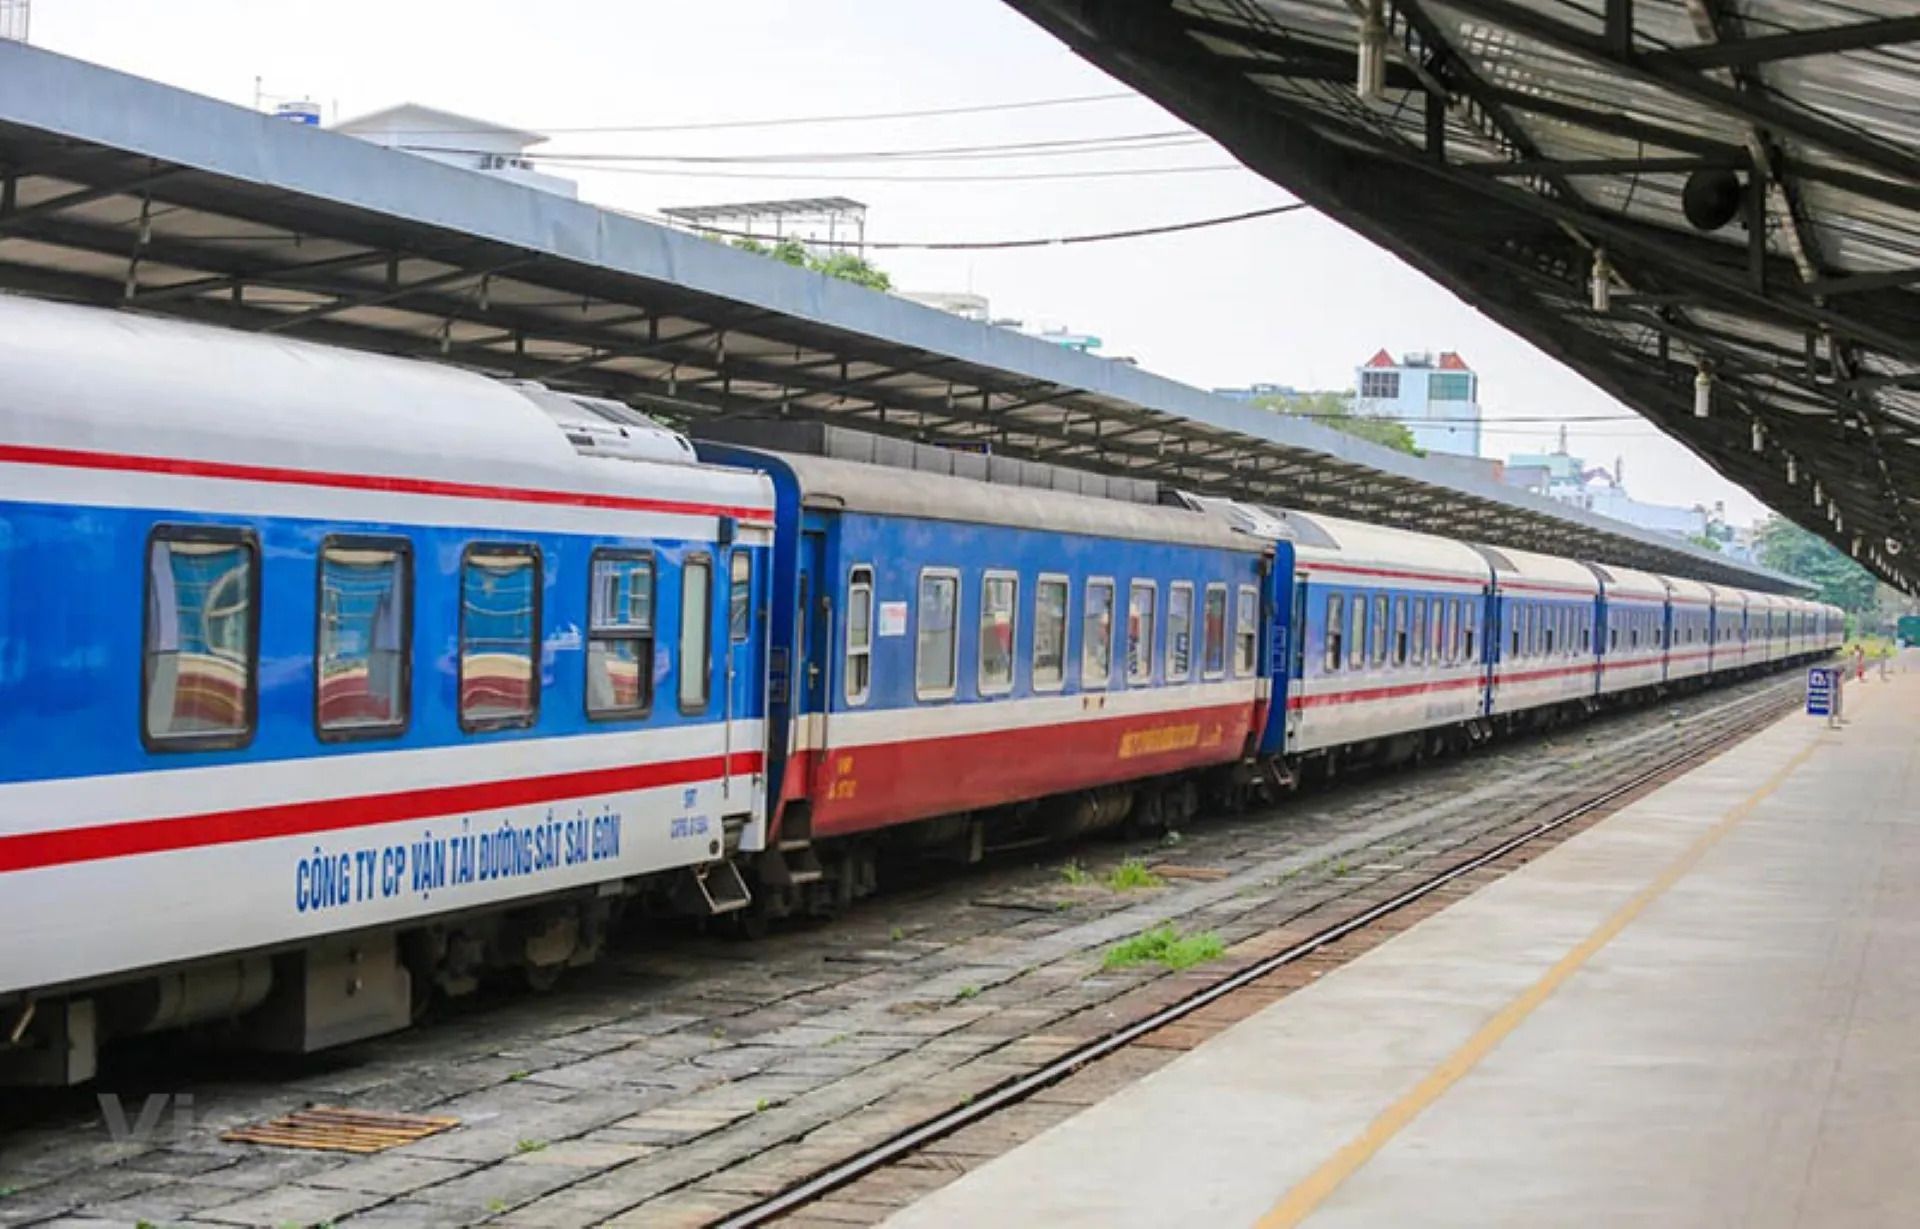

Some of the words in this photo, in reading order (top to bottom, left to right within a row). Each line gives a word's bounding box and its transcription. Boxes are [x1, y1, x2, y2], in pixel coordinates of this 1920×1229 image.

[297, 846, 350, 912] CÔNG
[356, 849, 377, 902] TY
[382, 846, 405, 897] CP
